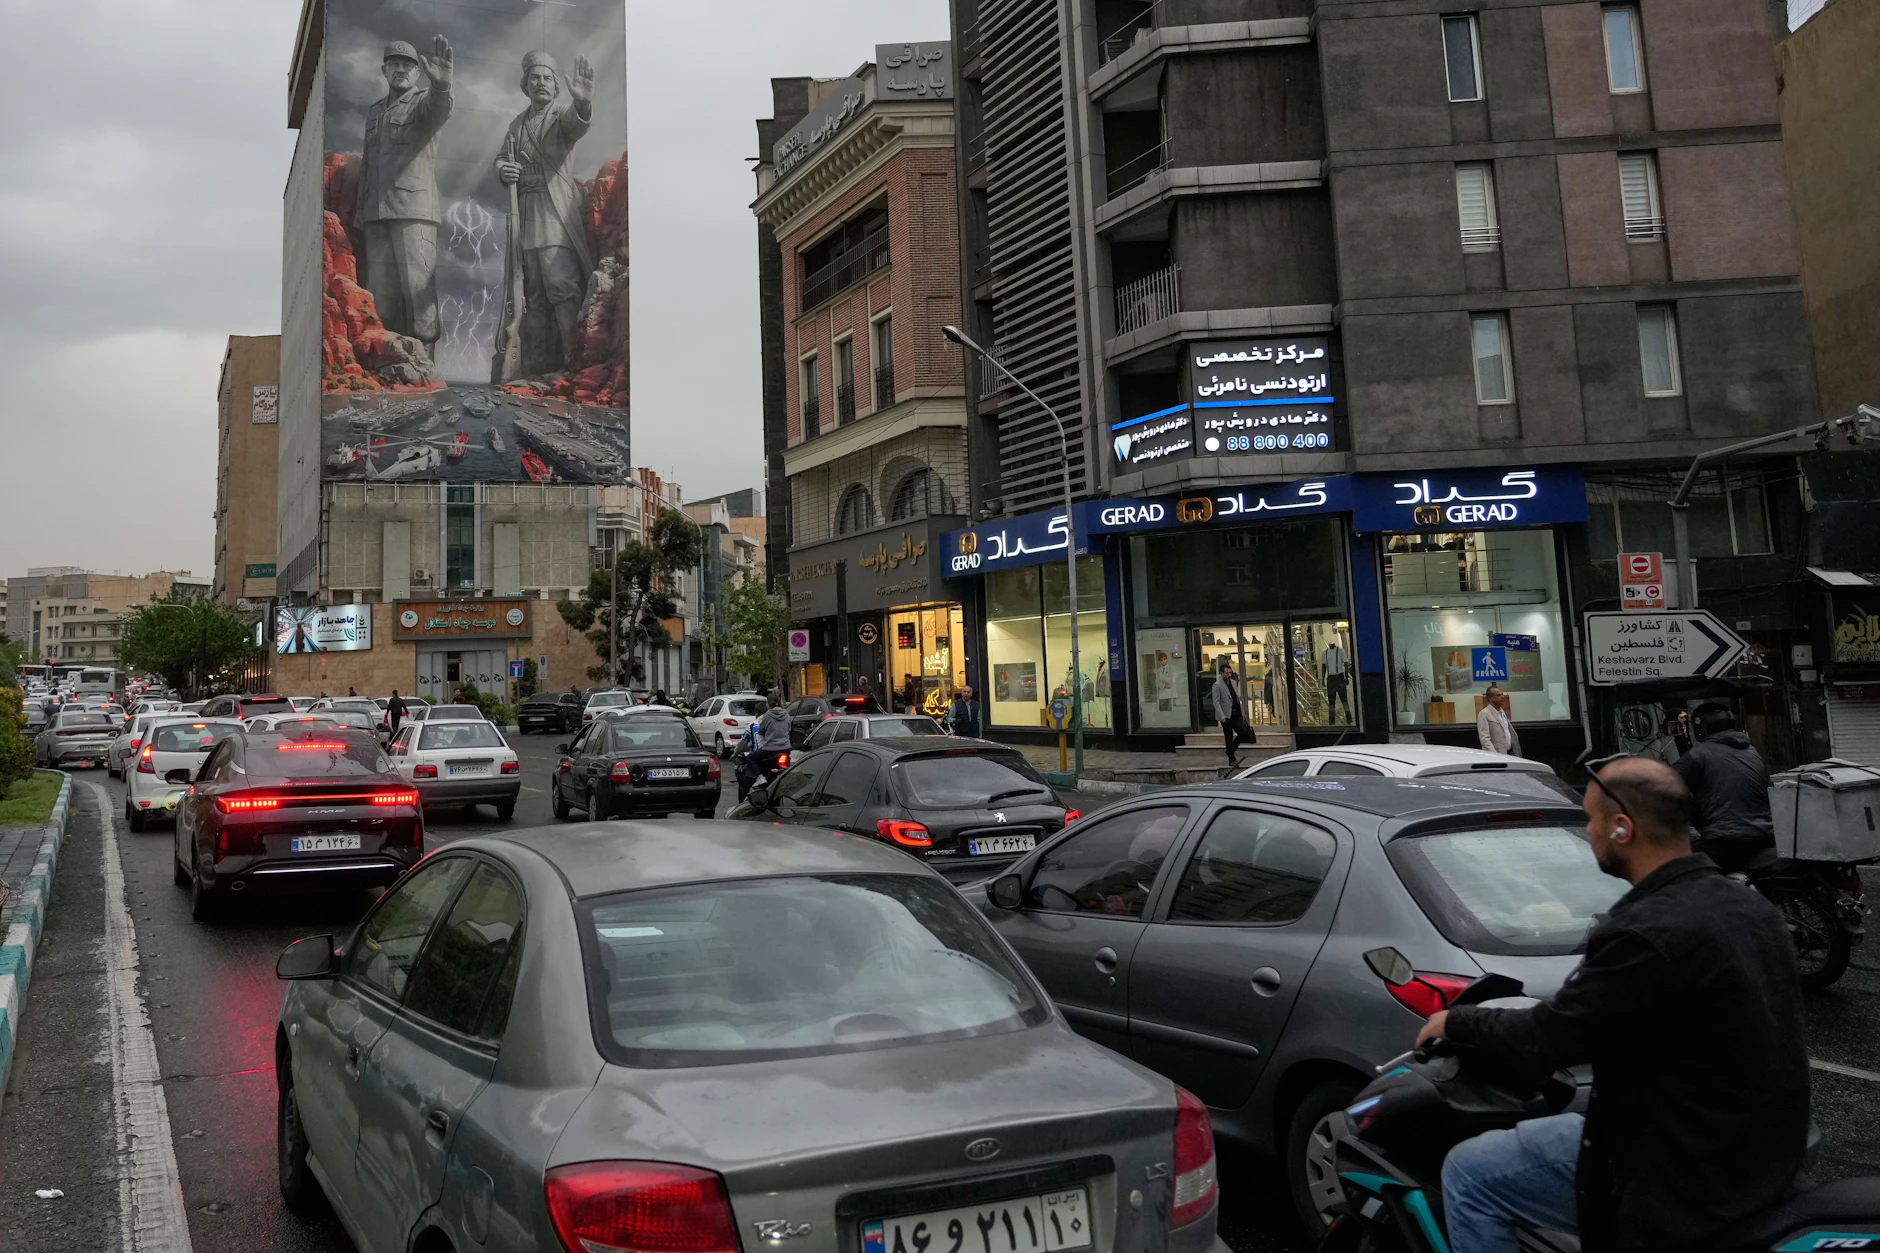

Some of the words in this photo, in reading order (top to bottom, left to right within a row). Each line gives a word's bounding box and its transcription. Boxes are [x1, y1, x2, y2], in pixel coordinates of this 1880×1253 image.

[886, 43, 943, 67] صرافی
[887, 72, 946, 97] پارسه
[832, 92, 864, 130] صرافی
[773, 143, 808, 182] EXCHANGE
[1196, 347, 1272, 367] تخصصی
[1276, 345, 1324, 364] مرکز
[1198, 375, 1247, 396] نامرئی
[1251, 374, 1326, 394] ارتودنسی
[254, 399, 277, 411] ایزوگام
[1174, 417, 1187, 429] دکتر
[1204, 417, 1225, 433] پور
[1227, 412, 1267, 428] درویش
[1269, 413, 1302, 426] هادی
[1304, 411, 1328, 424] دکتر
[1141, 425, 1160, 439] درویش
[1160, 421, 1175, 433] هادی
[1132, 432, 1142, 443] پور
[1226, 436, 1250, 450] 88
[1254, 434, 1289, 450] 800
[1293, 432, 1329, 448] 400
[1132, 446, 1163, 463] ارتودنسی
[1164, 439, 1190, 455] متخصص
[1394, 471, 1537, 505] گراد
[1217, 482, 1327, 515] گراد
[1101, 504, 1165, 525] GERAD
[1446, 503, 1517, 523] GERAD
[987, 515, 1069, 560] گراد
[889, 531, 927, 569] صرافی
[952, 553, 981, 572] GERAD
[318, 617, 334, 627] بازار
[334, 616, 355, 626] جاهد
[424, 617, 452, 630] استقلال
[454, 618, 471, 629] جهاد
[472, 618, 496, 628] موسسه
[1617, 620, 1662, 633] کشاورز
[1611, 637, 1664, 652] فلسطین
[1598, 656, 1656, 664] Keshavarz
[1659, 655, 1685, 664] Blvd.
[1599, 667, 1642, 676] Felestin
[1645, 668, 1663, 677] Sq.
[300, 839, 312, 850] ۱۵
[315, 838, 323, 849] م
[326, 837, 345, 848] ۱۳۴
[992, 839, 999, 850] م
[970, 1142, 995, 1157] KIA
[1145, 1163, 1168, 1180] LS
[1047, 1192, 1080, 1206] ایران
[753, 1219, 813, 1241] Rio
[892, 1222, 931, 1253] ۸۶
[948, 1218, 963, 1253] و
[977, 1204, 1038, 1253] ۲۱۱
[1050, 1208, 1083, 1246] ۱۰
[1813, 1238, 1871, 1248] 170
